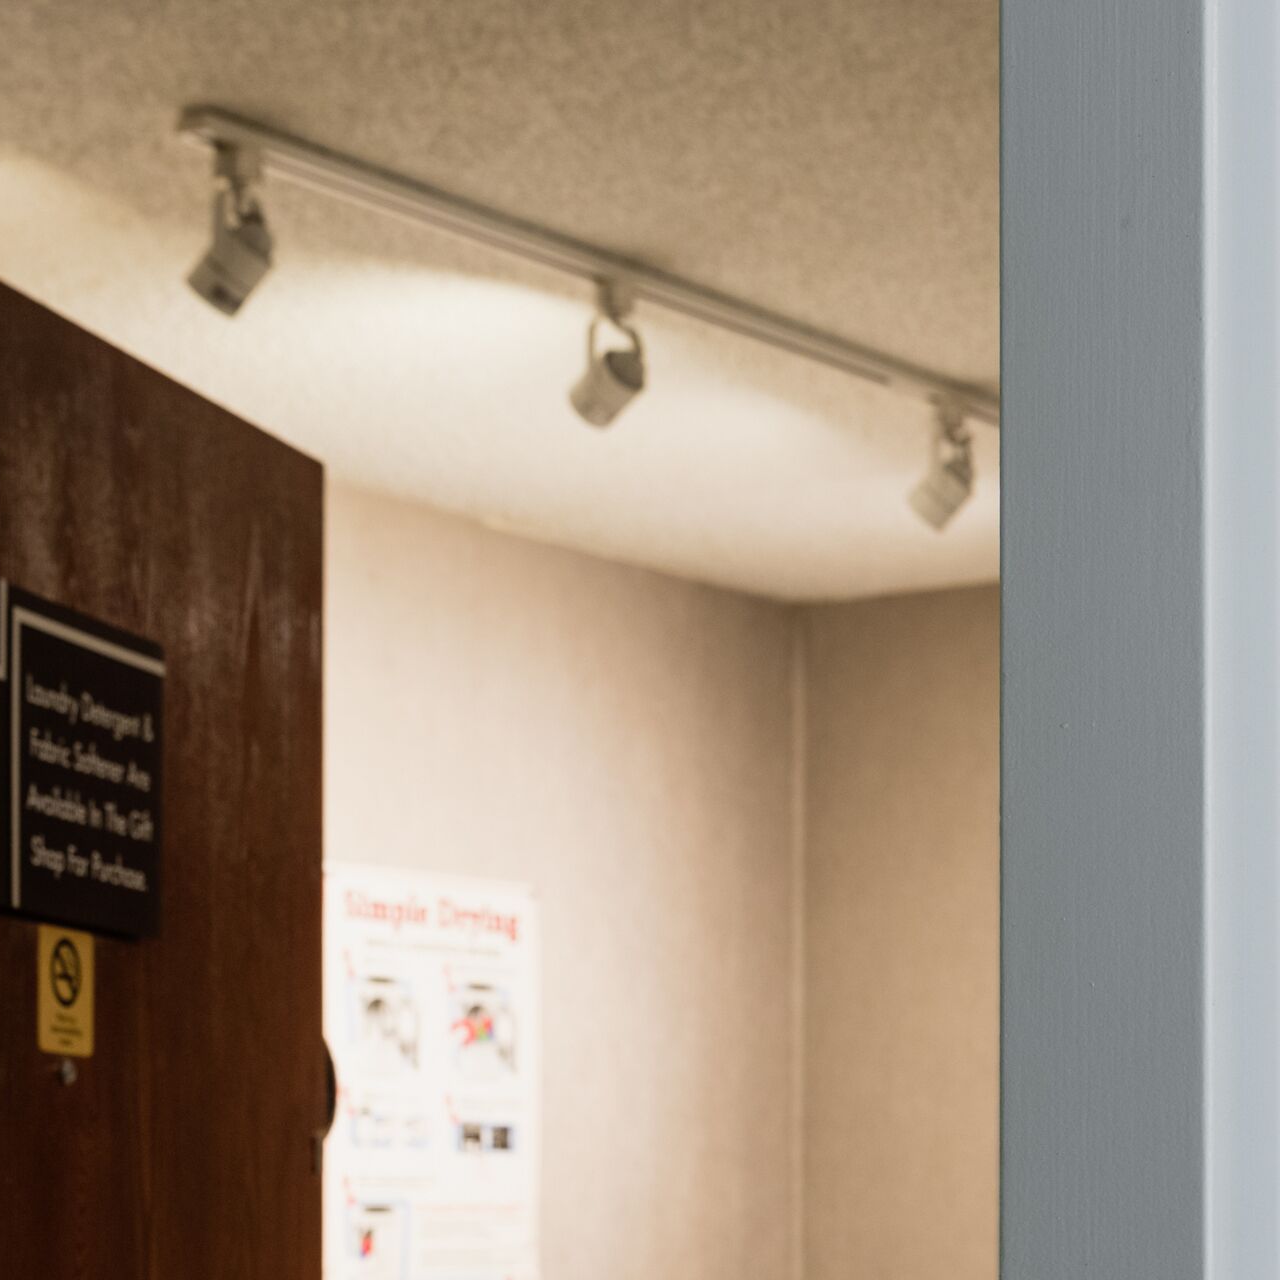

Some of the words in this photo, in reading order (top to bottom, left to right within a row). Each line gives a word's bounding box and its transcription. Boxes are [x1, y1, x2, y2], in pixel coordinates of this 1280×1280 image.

[25, 671, 79, 725] Laundry
[80, 690, 140, 740] Detergent
[29, 726, 71, 769] Fabric
[126, 760, 151, 793] Are
[25, 782, 87, 825] Available
[102, 801, 127, 837] The
[29, 834, 65, 879] Shop
